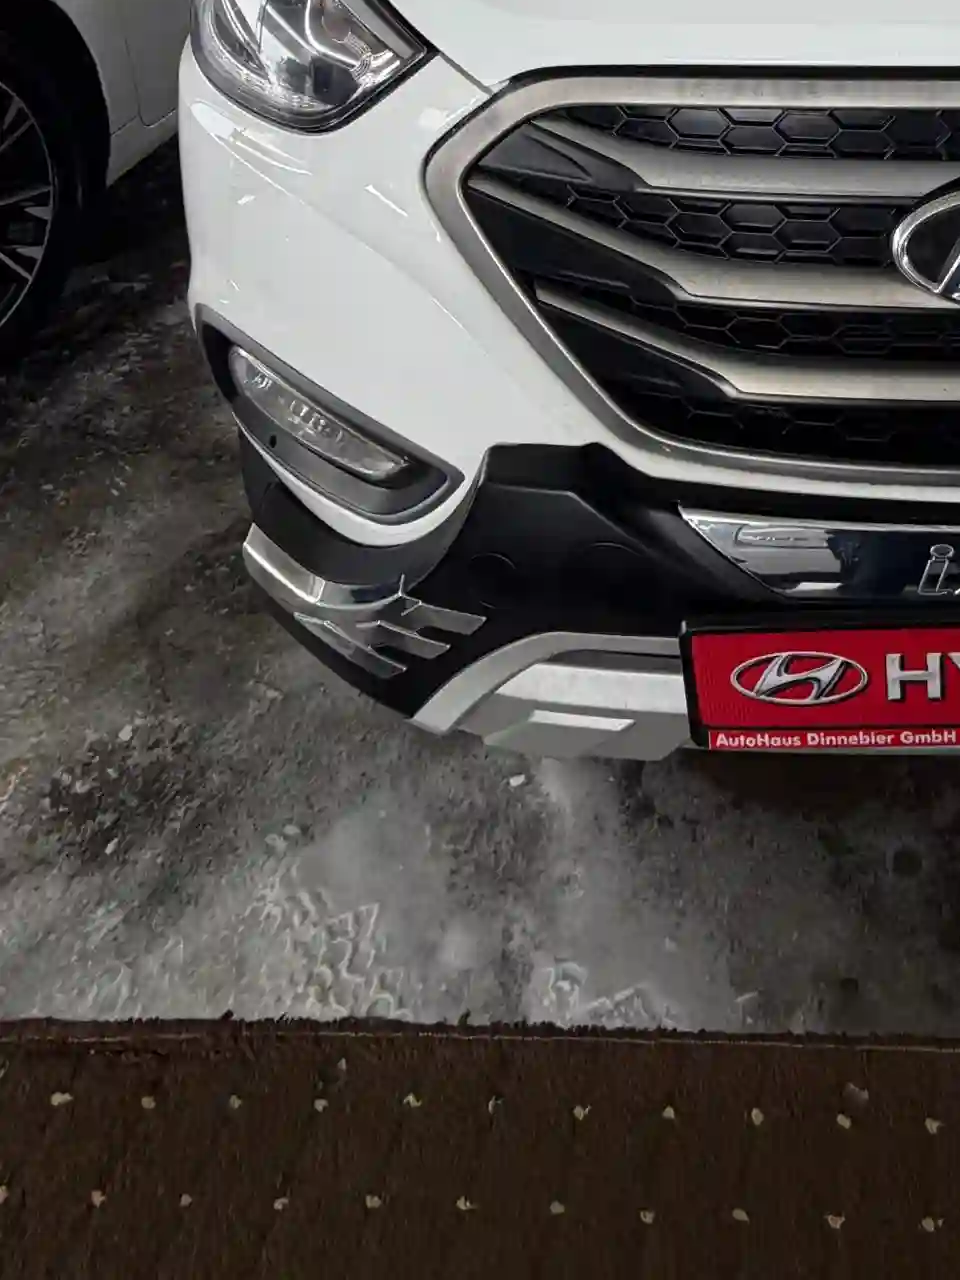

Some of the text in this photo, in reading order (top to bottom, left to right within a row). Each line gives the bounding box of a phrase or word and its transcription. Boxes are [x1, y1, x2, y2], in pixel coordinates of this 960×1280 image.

[715, 729, 957, 748] AutoHaus Dinnebier GmbH
